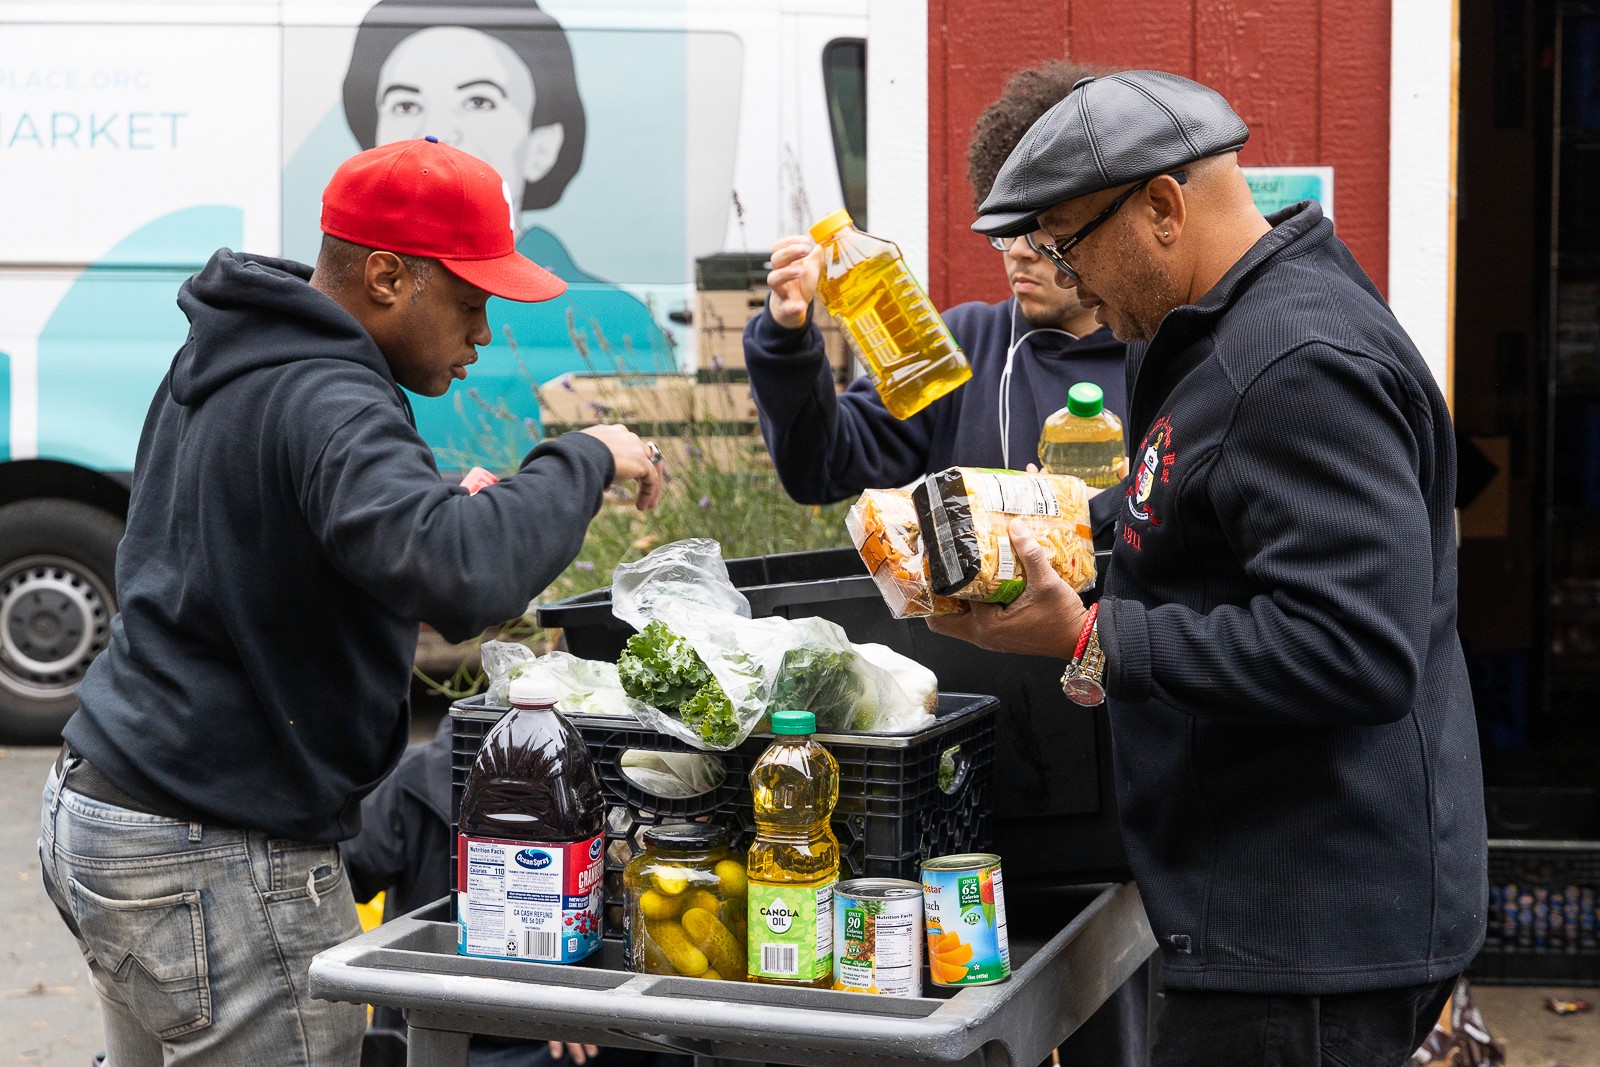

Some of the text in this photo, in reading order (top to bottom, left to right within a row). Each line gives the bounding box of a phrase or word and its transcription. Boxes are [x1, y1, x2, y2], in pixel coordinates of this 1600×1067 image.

[0, 111, 189, 149] ARKET
[516, 853, 533, 866] Ocean
[533, 856, 550, 868] Spray
[494, 868, 505, 876] 110
[961, 883, 977, 895] 65
[520, 909, 534, 917] CASH
[533, 910, 553, 919] REFUND
[760, 907, 799, 917] CANOLA
[535, 917, 545, 925] DEP
[772, 917, 786, 926] OIL
[848, 917, 861, 929] 90
[846, 926, 863, 935] Calories
